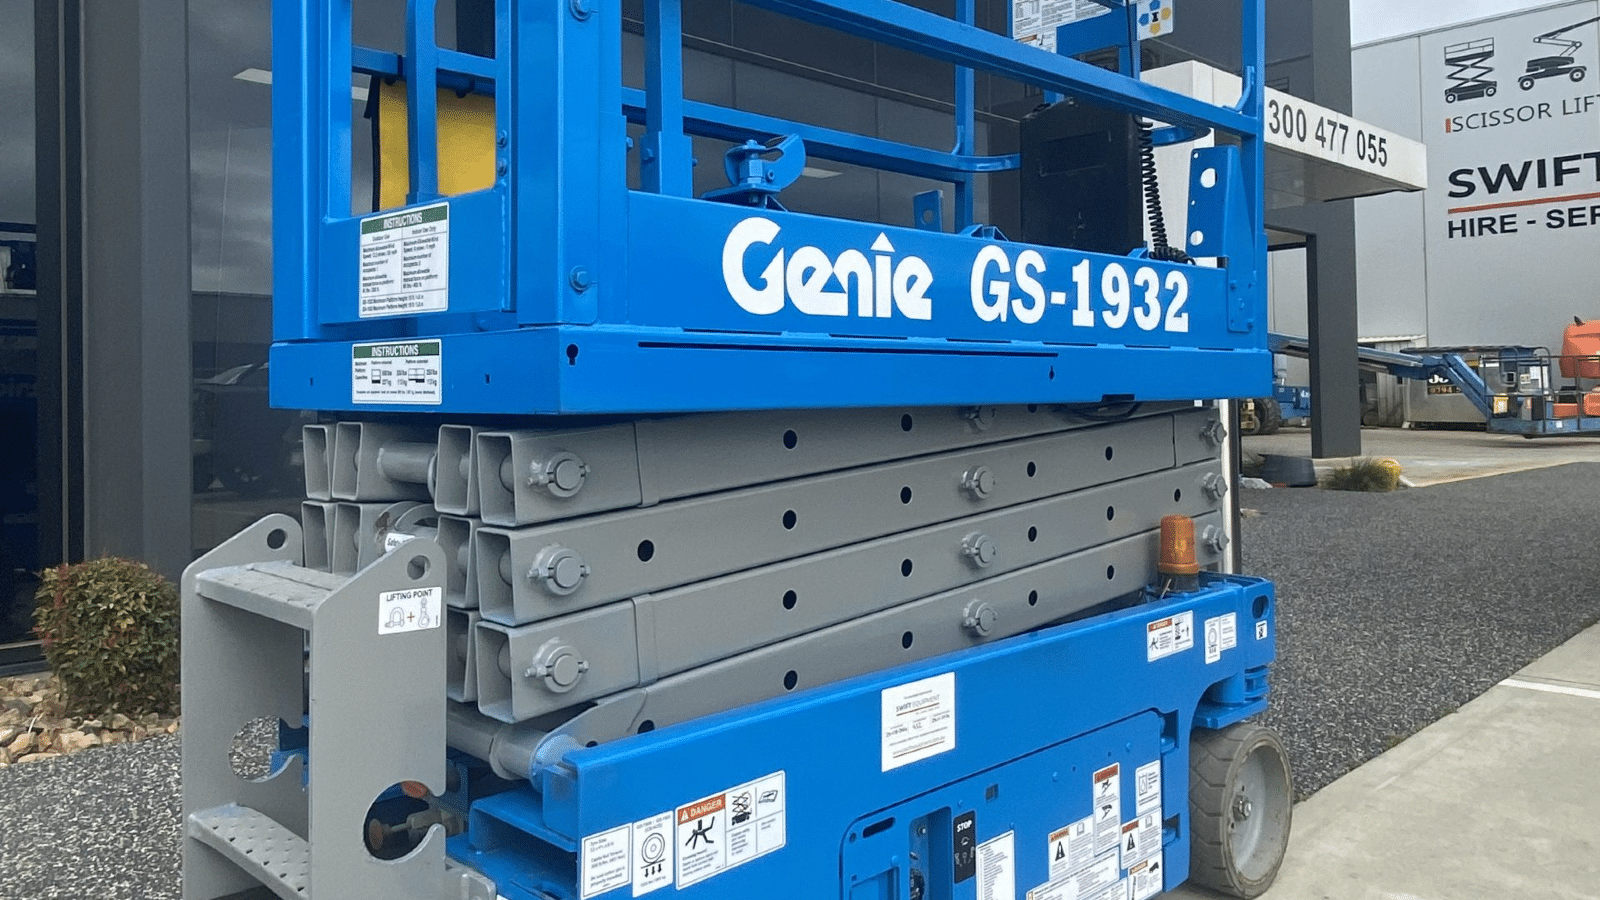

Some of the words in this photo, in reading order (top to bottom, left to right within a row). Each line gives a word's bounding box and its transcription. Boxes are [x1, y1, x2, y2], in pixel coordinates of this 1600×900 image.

[1452, 103, 1552, 132] SCISSOR
[1562, 94, 1600, 116] LIF
[1268, 99, 1307, 142] 300
[1315, 116, 1349, 155] 477
[1356, 129, 1388, 167] 055
[1448, 151, 1600, 198] SWIFT
[383, 212, 423, 229] INSTRUCTIONS
[1448, 213, 1518, 238] HIRE
[722, 217, 933, 320] Genie
[970, 244, 1189, 333] GS-1932
[371, 344, 419, 357] INSTRUCTIONS
[386, 591, 412, 602] LIFTING
[413, 588, 433, 599] POINT
[895, 702, 911, 712] SWIFT
[690, 798, 722, 818] DANGER
[956, 819, 973, 833] STOP
